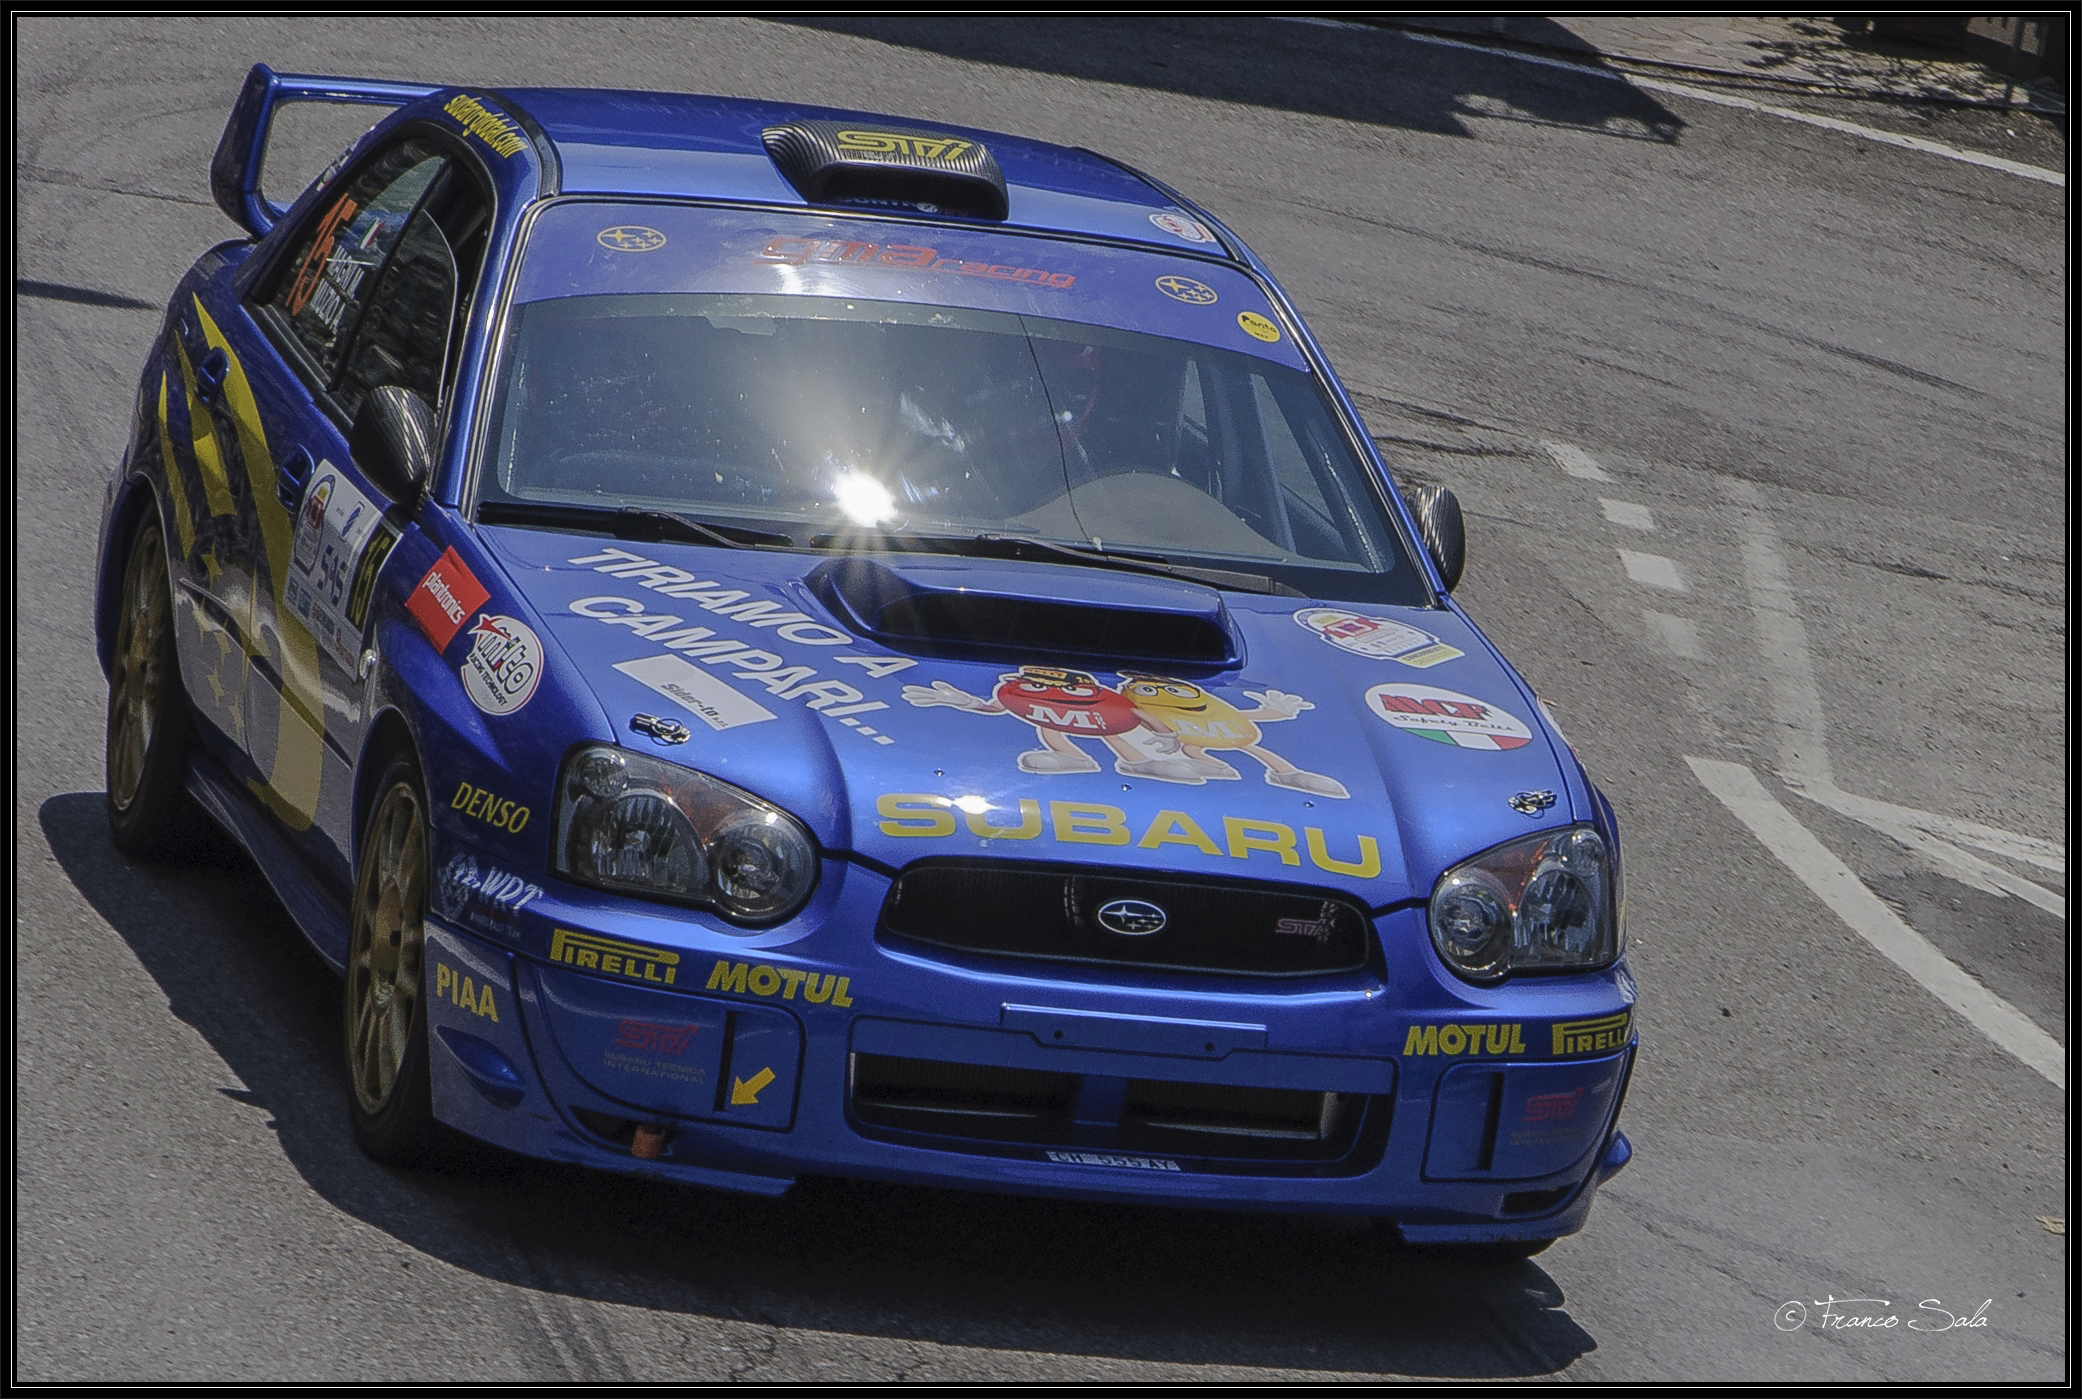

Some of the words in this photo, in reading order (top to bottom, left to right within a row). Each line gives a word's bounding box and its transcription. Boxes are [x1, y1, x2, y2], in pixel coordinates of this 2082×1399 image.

[284, 191, 359, 317] 15
[933, 257, 1077, 289] racing
[422, 571, 466, 625] plantronics
[568, 548, 853, 646] TIRIAMO
[832, 656, 919, 679] A
[568, 596, 897, 746] CAMPARI...
[1393, 715, 1460, 726] Safety
[451, 782, 530, 834] DENSO
[876, 793, 1381, 879] SUBARU
[480, 866, 544, 910] WDT
[550, 929, 680, 984] PIRELLI
[706, 959, 853, 1008] MOTUL
[435, 962, 499, 1022] PIAA
[1402, 1024, 1526, 1056] MOTUL
